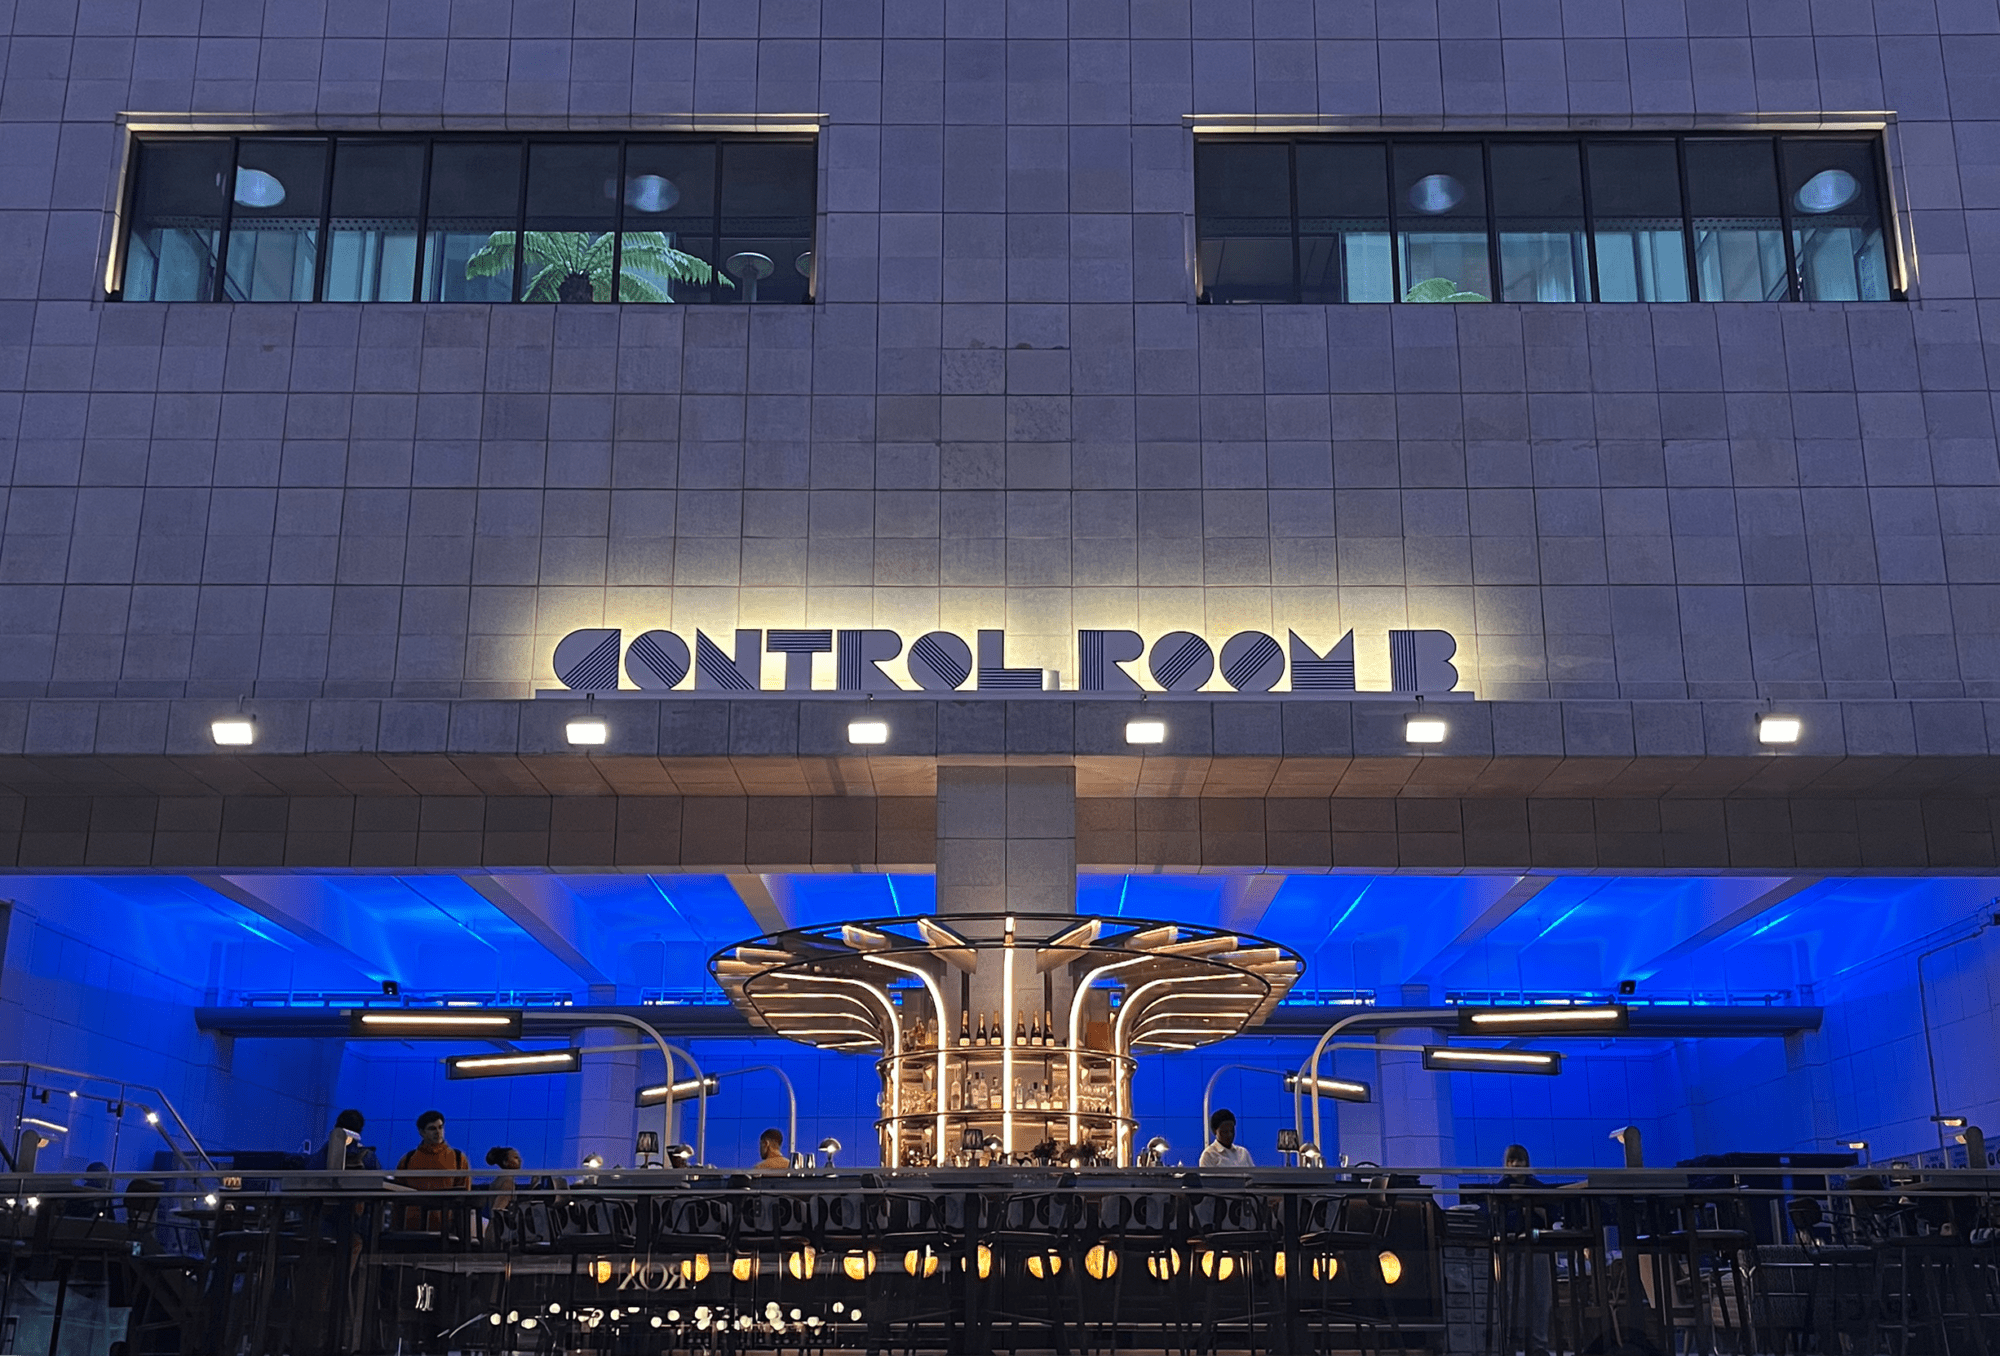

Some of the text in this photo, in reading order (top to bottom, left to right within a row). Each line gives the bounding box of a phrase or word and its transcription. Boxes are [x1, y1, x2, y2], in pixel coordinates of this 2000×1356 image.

[553, 628, 1459, 692] CONTROL ROOM B
